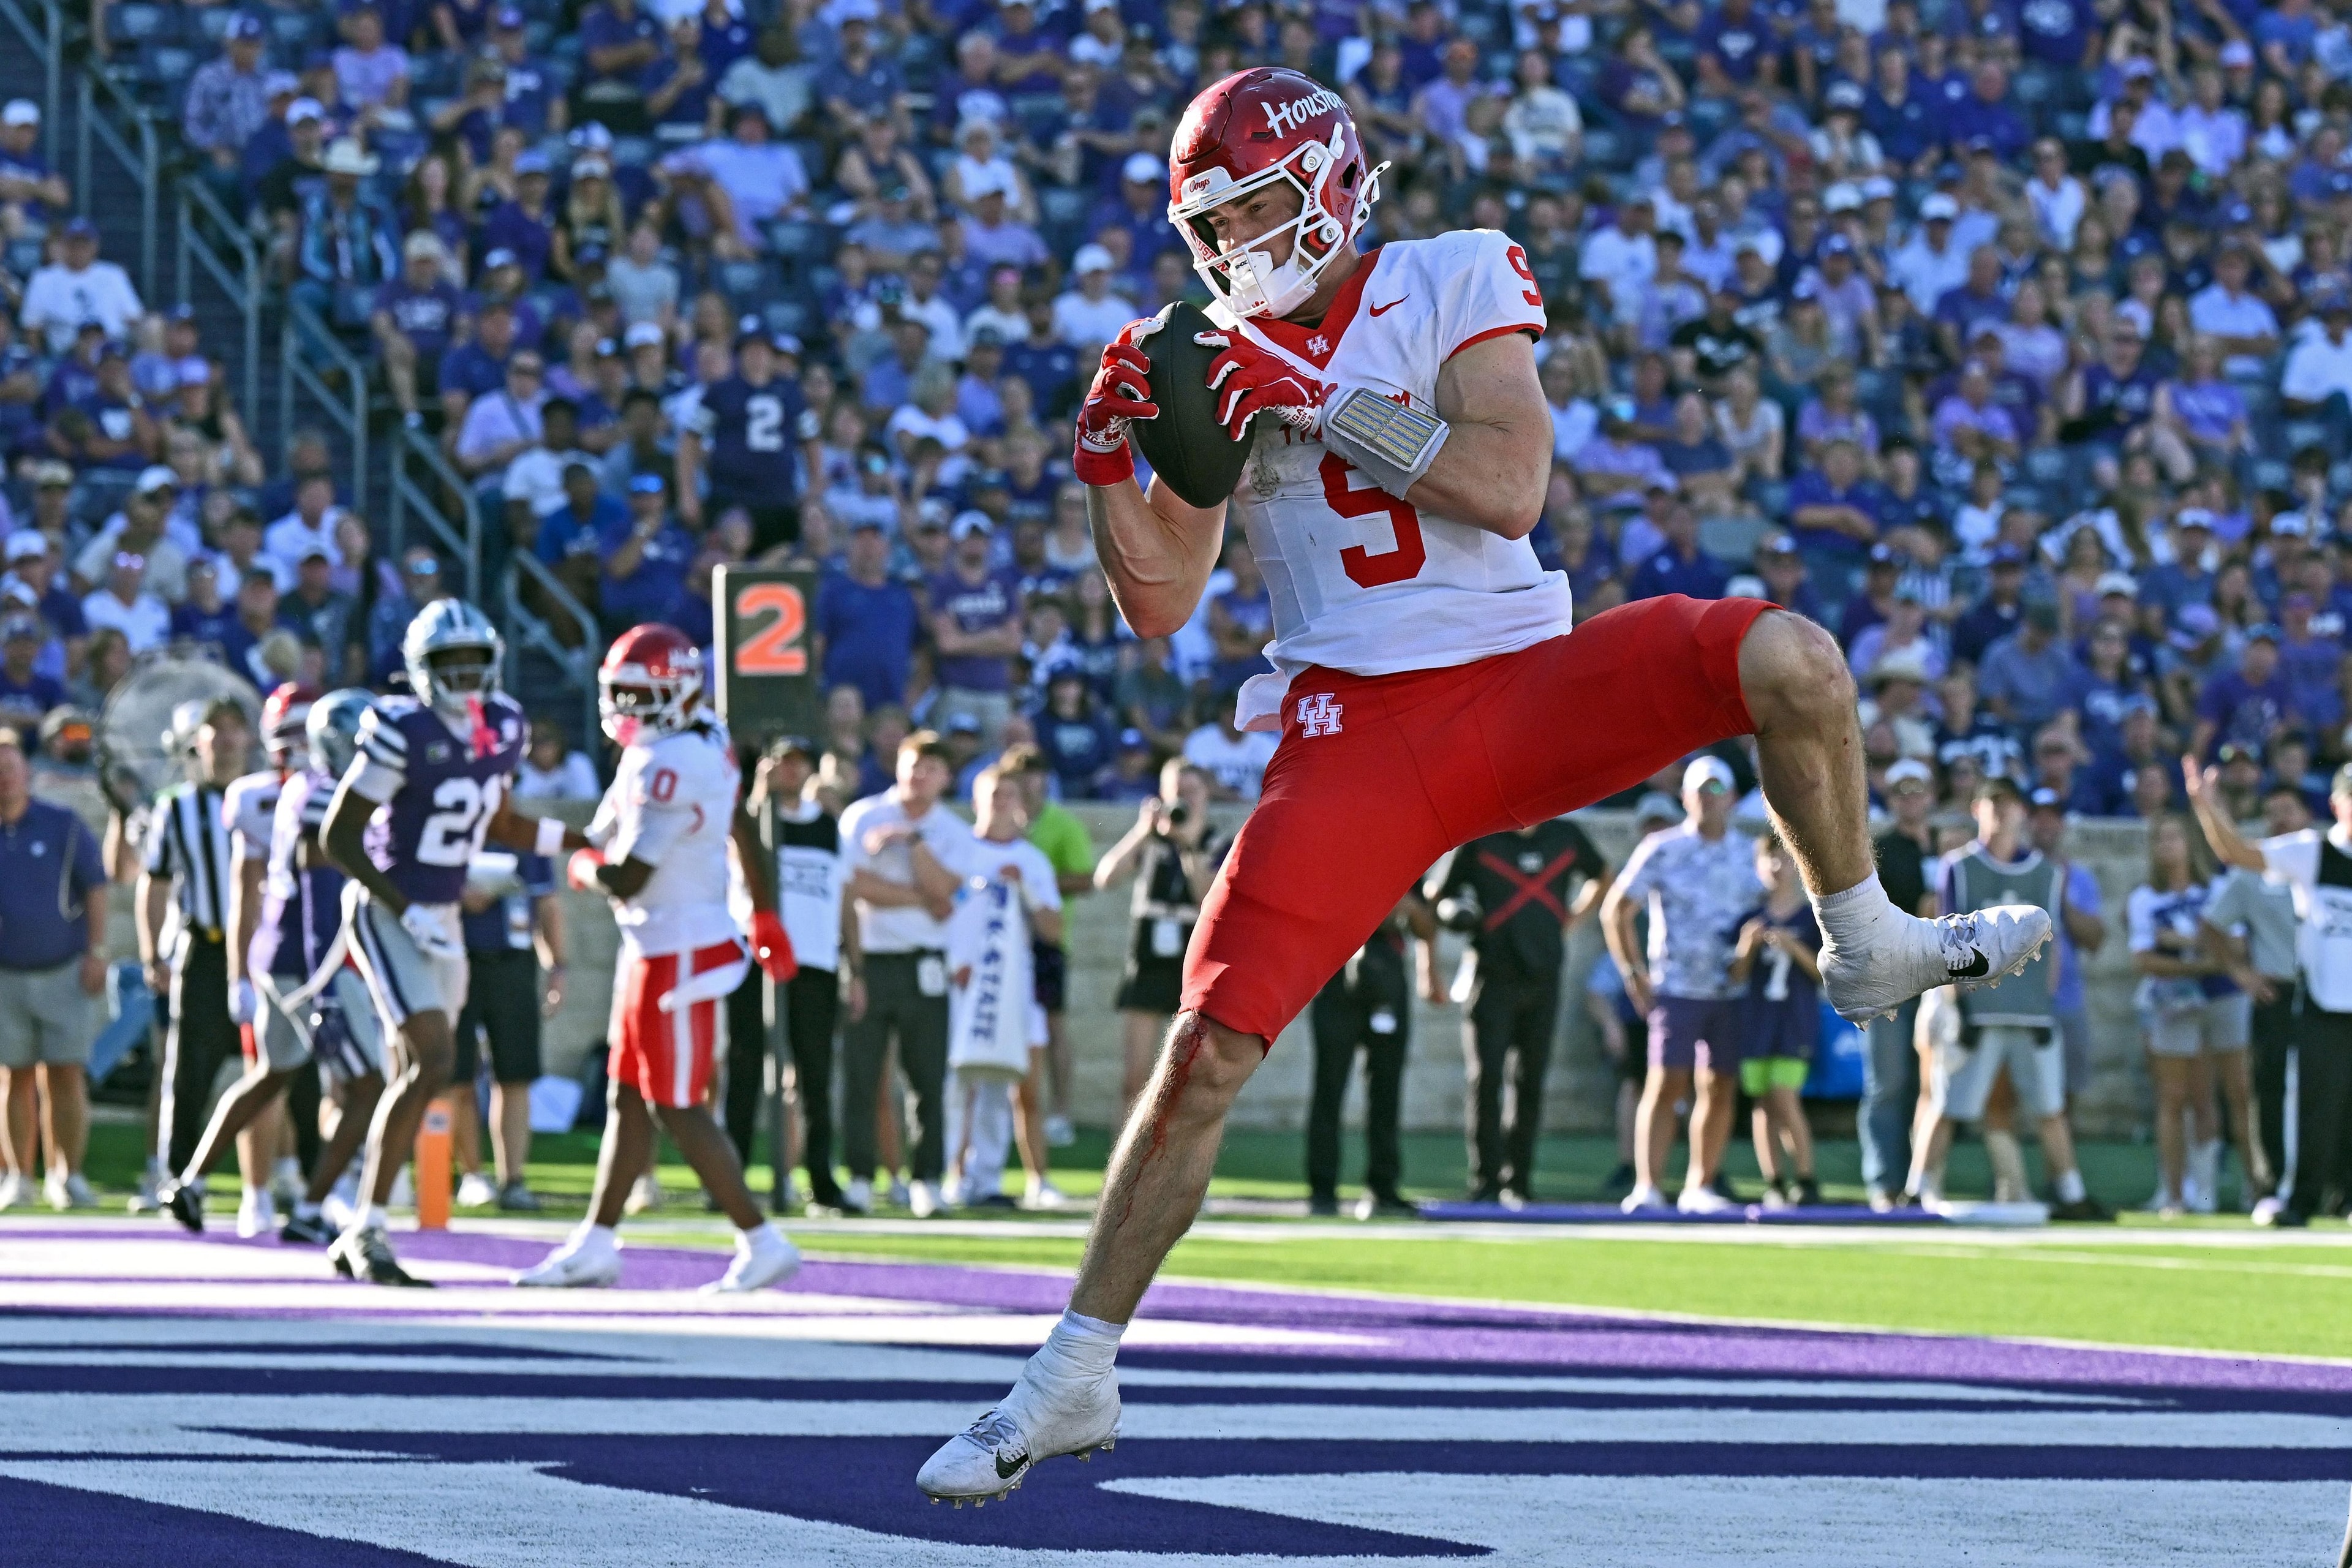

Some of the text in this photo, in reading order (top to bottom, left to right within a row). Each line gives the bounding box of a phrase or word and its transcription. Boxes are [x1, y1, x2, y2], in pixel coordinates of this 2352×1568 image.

[1261, 85, 1349, 138] Houston
[1506, 246, 1542, 307] 9
[745, 393, 784, 452] 2
[735, 582, 808, 676] 2
[652, 767, 678, 803] 0
